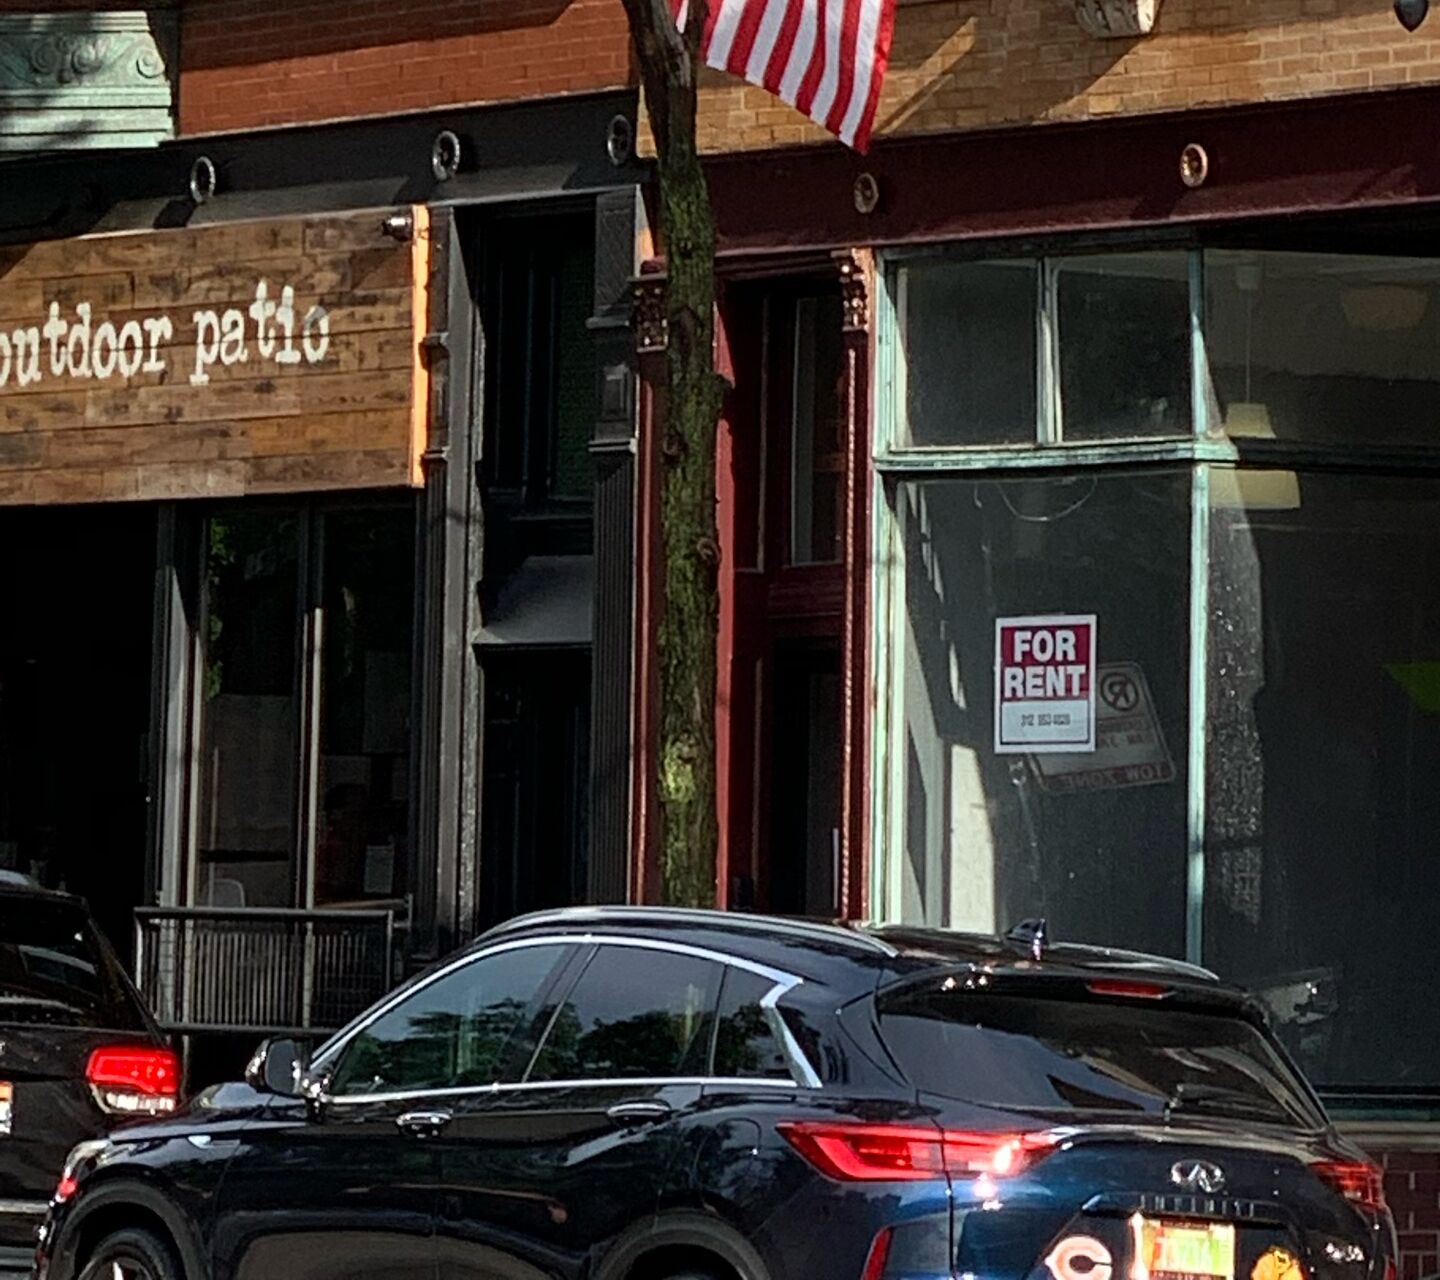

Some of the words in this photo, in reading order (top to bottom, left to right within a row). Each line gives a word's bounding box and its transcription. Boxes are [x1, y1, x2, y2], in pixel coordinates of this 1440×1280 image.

[189, 278, 330, 386] patio
[1014, 630, 1077, 663] FOR
[1003, 665, 1087, 699] RENT
